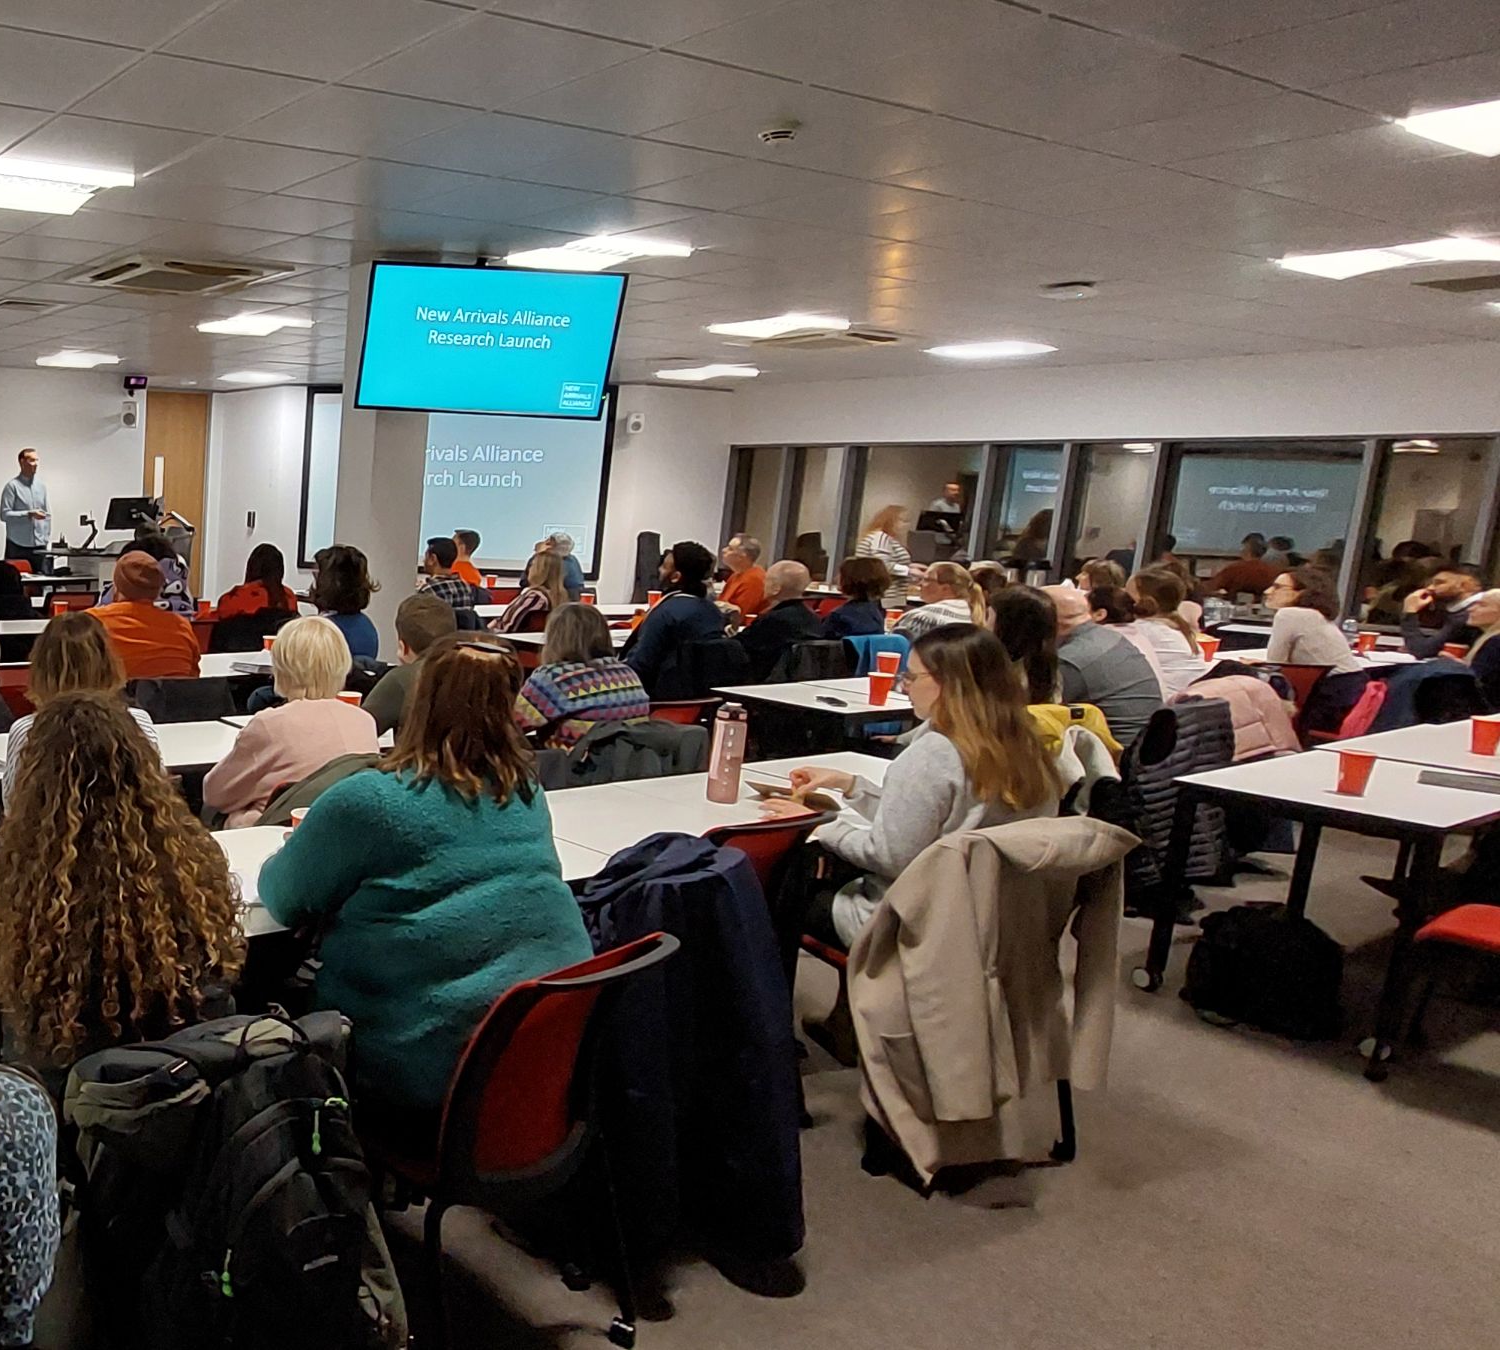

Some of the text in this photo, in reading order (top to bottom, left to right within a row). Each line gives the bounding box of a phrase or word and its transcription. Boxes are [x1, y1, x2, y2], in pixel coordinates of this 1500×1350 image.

[416, 306, 571, 327] New Arrivals Alliance
[428, 330, 551, 349] Research Launch
[472, 445, 544, 463] Alliance
[459, 470, 522, 488] Launch
